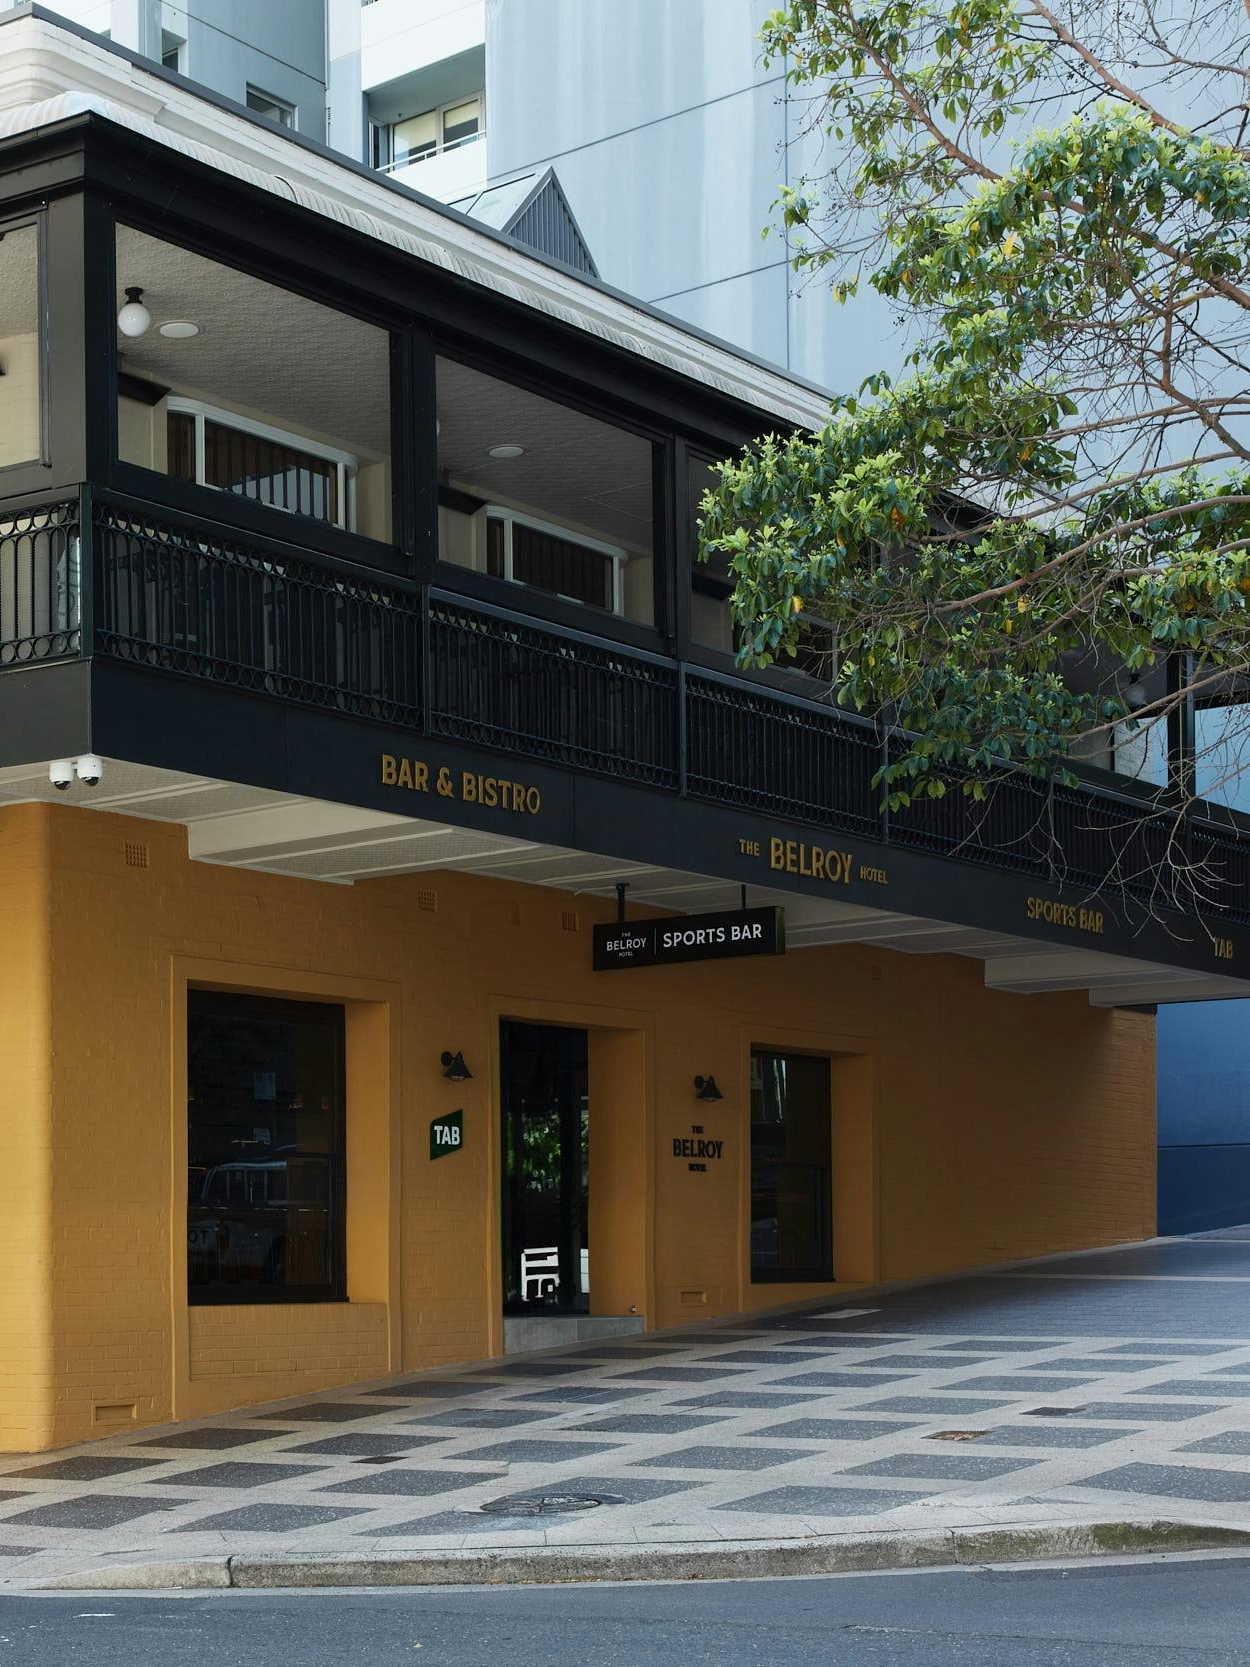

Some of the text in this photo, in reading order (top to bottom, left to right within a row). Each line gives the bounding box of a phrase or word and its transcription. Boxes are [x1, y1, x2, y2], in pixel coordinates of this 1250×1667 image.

[382, 754, 541, 815] BAR & BISTRO
[739, 836, 888, 884] THE BELROY HOTEL
[1027, 896, 1104, 934] SPORTS BAR
[606, 937, 647, 952] BELROY
[663, 923, 763, 948] SPORTS BAR
[1213, 936, 1234, 960] TAB
[433, 1125, 461, 1146] TAB
[673, 1138, 723, 1159] BELROY
